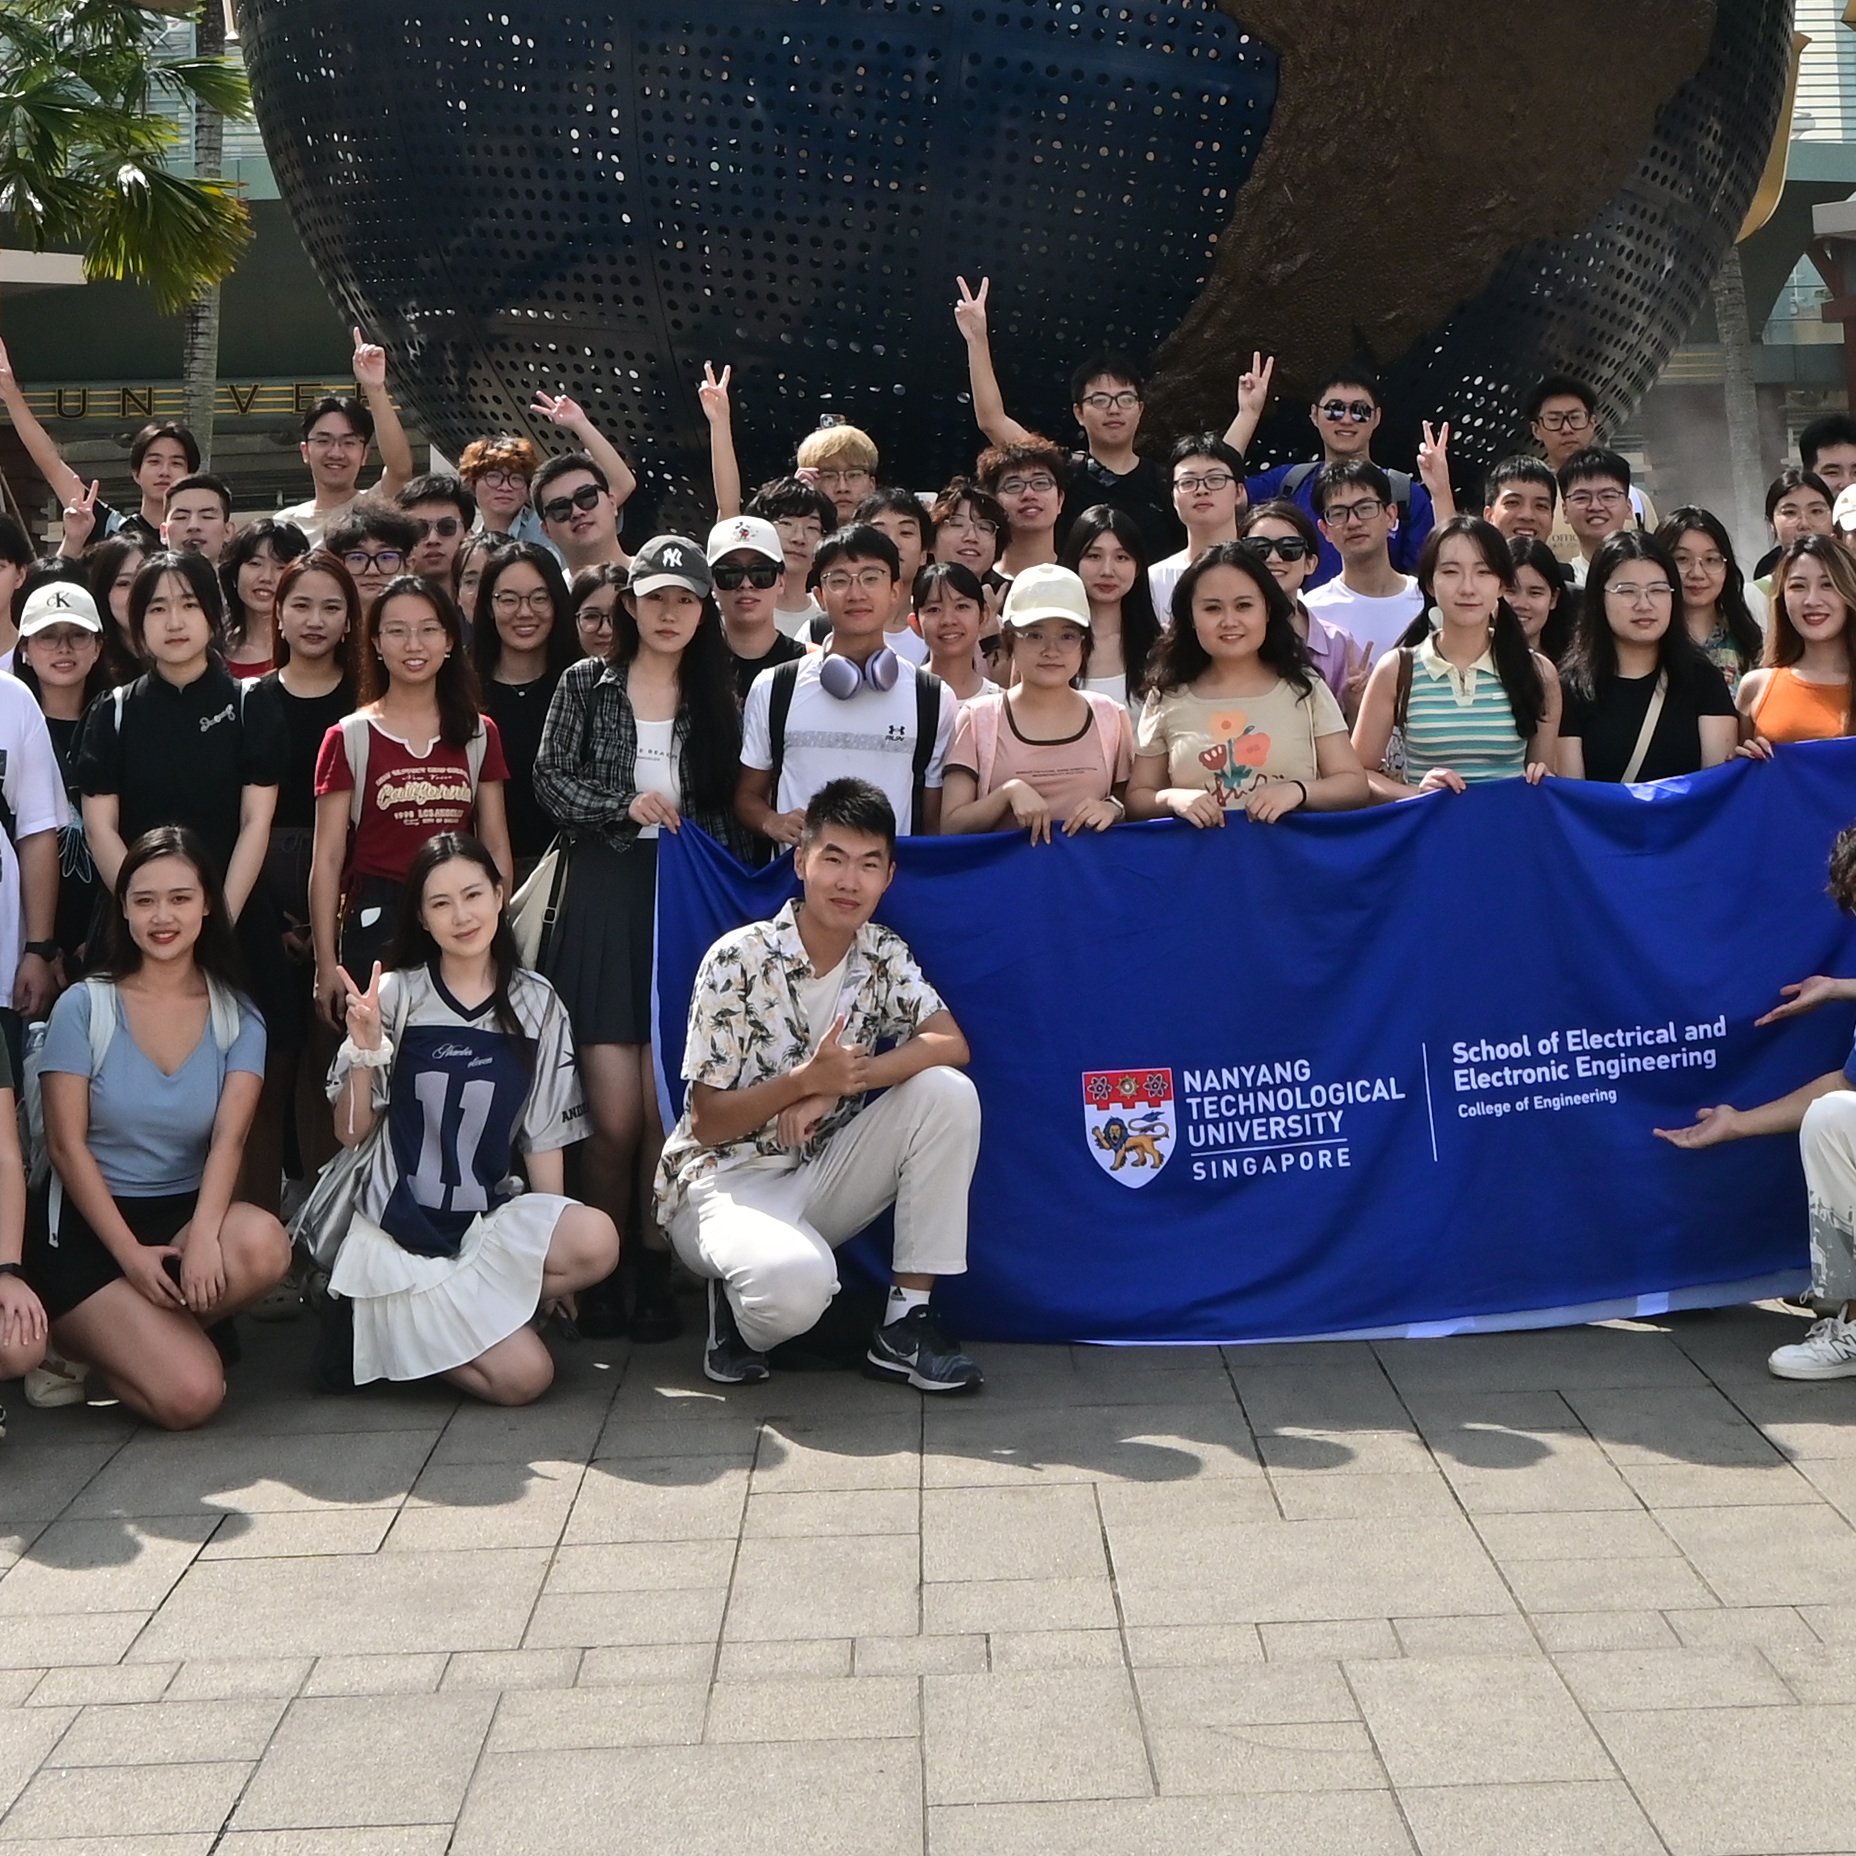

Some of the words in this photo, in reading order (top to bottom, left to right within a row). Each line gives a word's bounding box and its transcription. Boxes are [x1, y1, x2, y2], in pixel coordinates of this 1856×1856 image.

[55, 381, 370, 419] UNVE
[662, 548, 683, 568] NY
[1452, 1034, 1532, 1064] School
[1537, 1031, 1560, 1055] of
[1566, 1021, 1677, 1052] Electrical
[1684, 1014, 1727, 1041] and
[1183, 1059, 1311, 1093] NANYANG
[1453, 1059, 1570, 1092] Electronic
[1575, 1047, 1717, 1080] Engineering
[1185, 1077, 1406, 1120] TECHNOLOGICAL
[1457, 1099, 1511, 1119] College
[1515, 1096, 1530, 1111] of
[1533, 1088, 1618, 1111] Engineering
[406, 1070, 496, 1212] 11
[1188, 1109, 1344, 1147] UNIVERSITY
[1192, 1147, 1351, 1181] SINGAPORE
